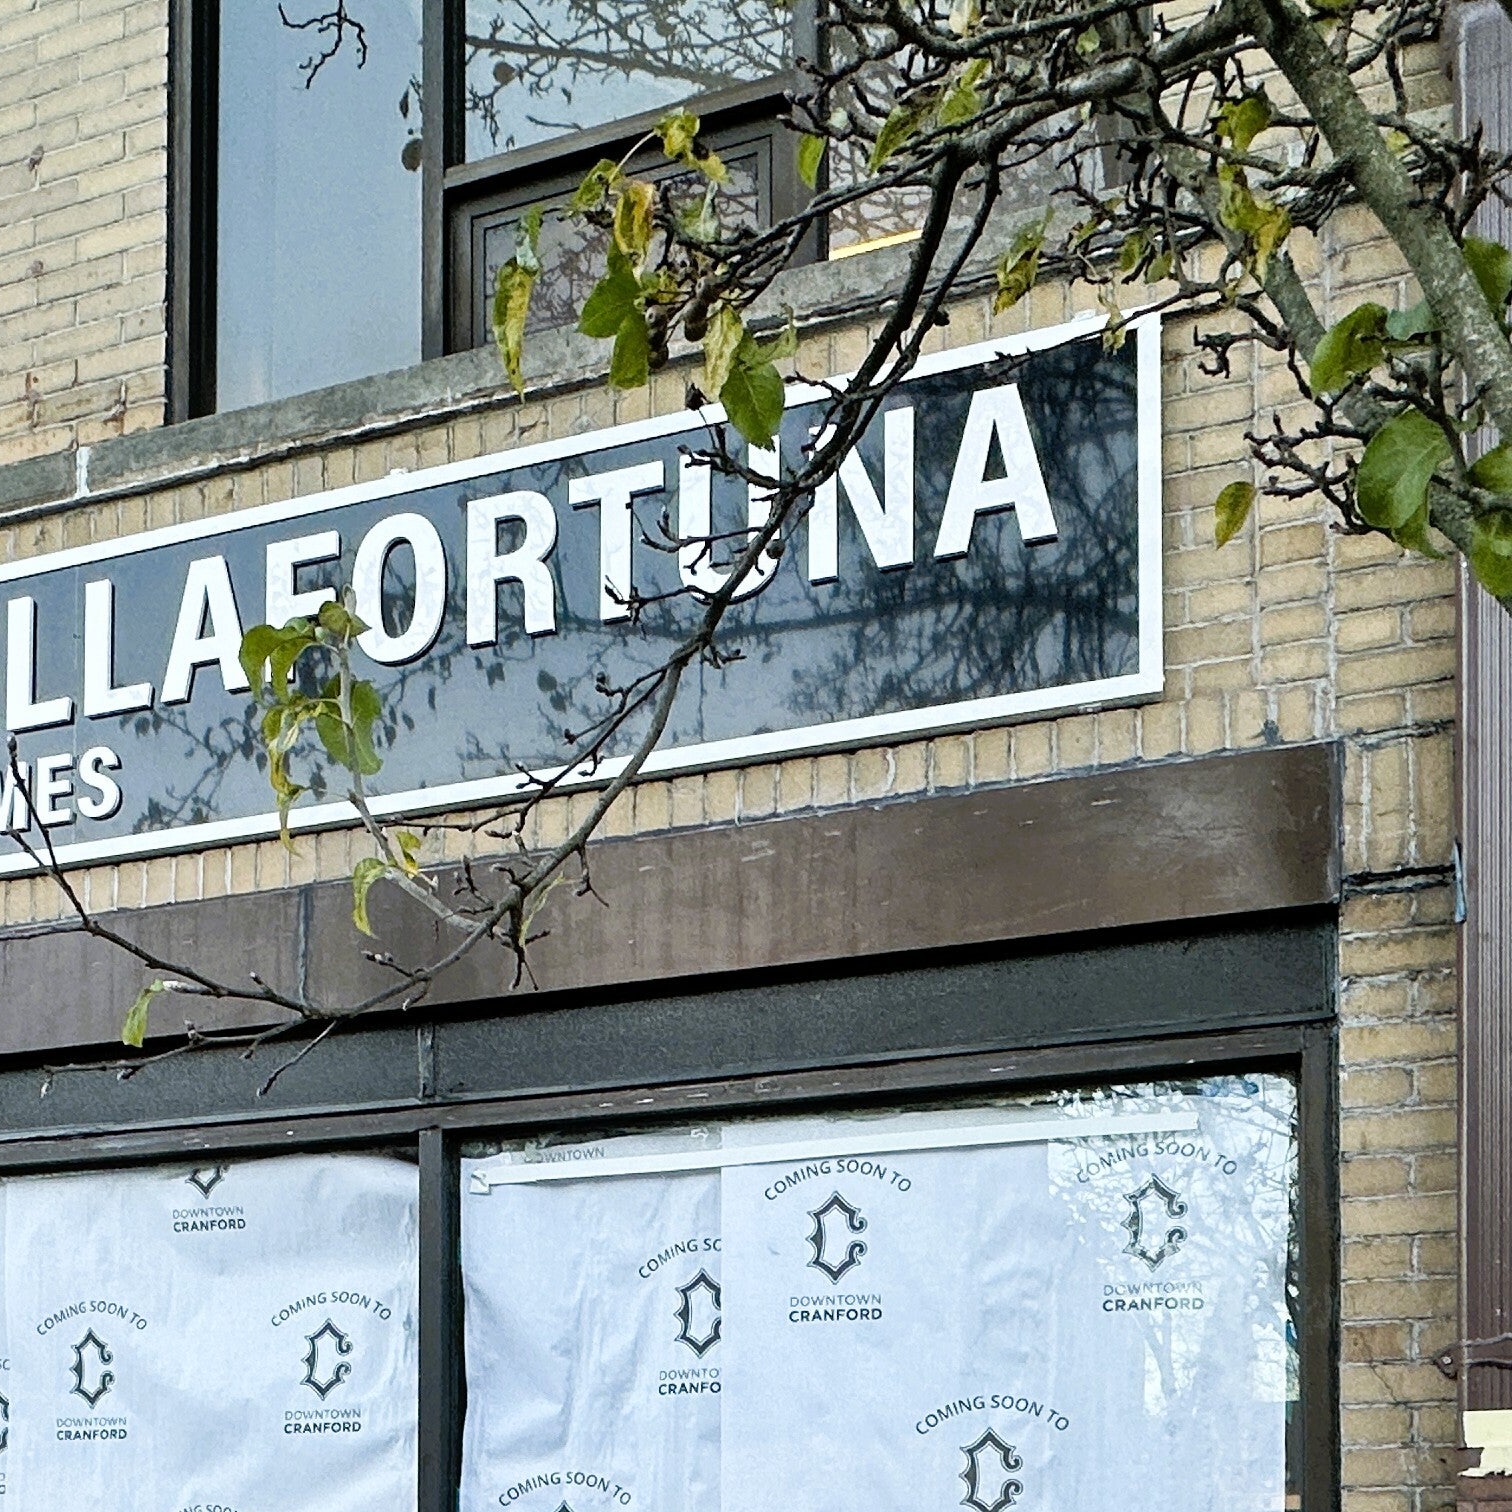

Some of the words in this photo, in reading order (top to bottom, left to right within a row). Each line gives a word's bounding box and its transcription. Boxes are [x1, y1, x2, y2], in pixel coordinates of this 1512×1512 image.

[1077, 1142, 1149, 1185] COMING
[1154, 1141, 1210, 1164] SOON
[1214, 1155, 1237, 1177] TO
[763, 1163, 832, 1202] COMING
[836, 1158, 886, 1181] SOON
[892, 1171, 912, 1193] TO
[172, 1206, 244, 1219] DOWNTOWN
[173, 1218, 246, 1233] CRANFORD
[638, 1238, 699, 1279] COMING
[1103, 1282, 1203, 1296] DOWNTOWN
[789, 1294, 882, 1308] DOWNTOWN
[1102, 1297, 1204, 1313] CRANFORD
[271, 1292, 327, 1328] COMING
[331, 1291, 371, 1310] SOON
[373, 1301, 392, 1322] TO
[788, 1308, 883, 1323] CRANFORD
[36, 1301, 87, 1336] COMING
[90, 1300, 129, 1320] SOON
[130, 1313, 148, 1331] TO
[57, 1417, 127, 1427] DOWNTOWN
[284, 1408, 362, 1422] DOWNTOWN
[915, 1395, 986, 1437] COMING
[990, 1394, 1044, 1418] SOON
[1047, 1412, 1070, 1433] TO
[57, 1429, 127, 1441] CRANFORD
[284, 1421, 362, 1434] CRANFORD
[498, 1471, 562, 1509] COMING
[566, 1471, 610, 1493] SOON
[613, 1486, 632, 1507] TO
